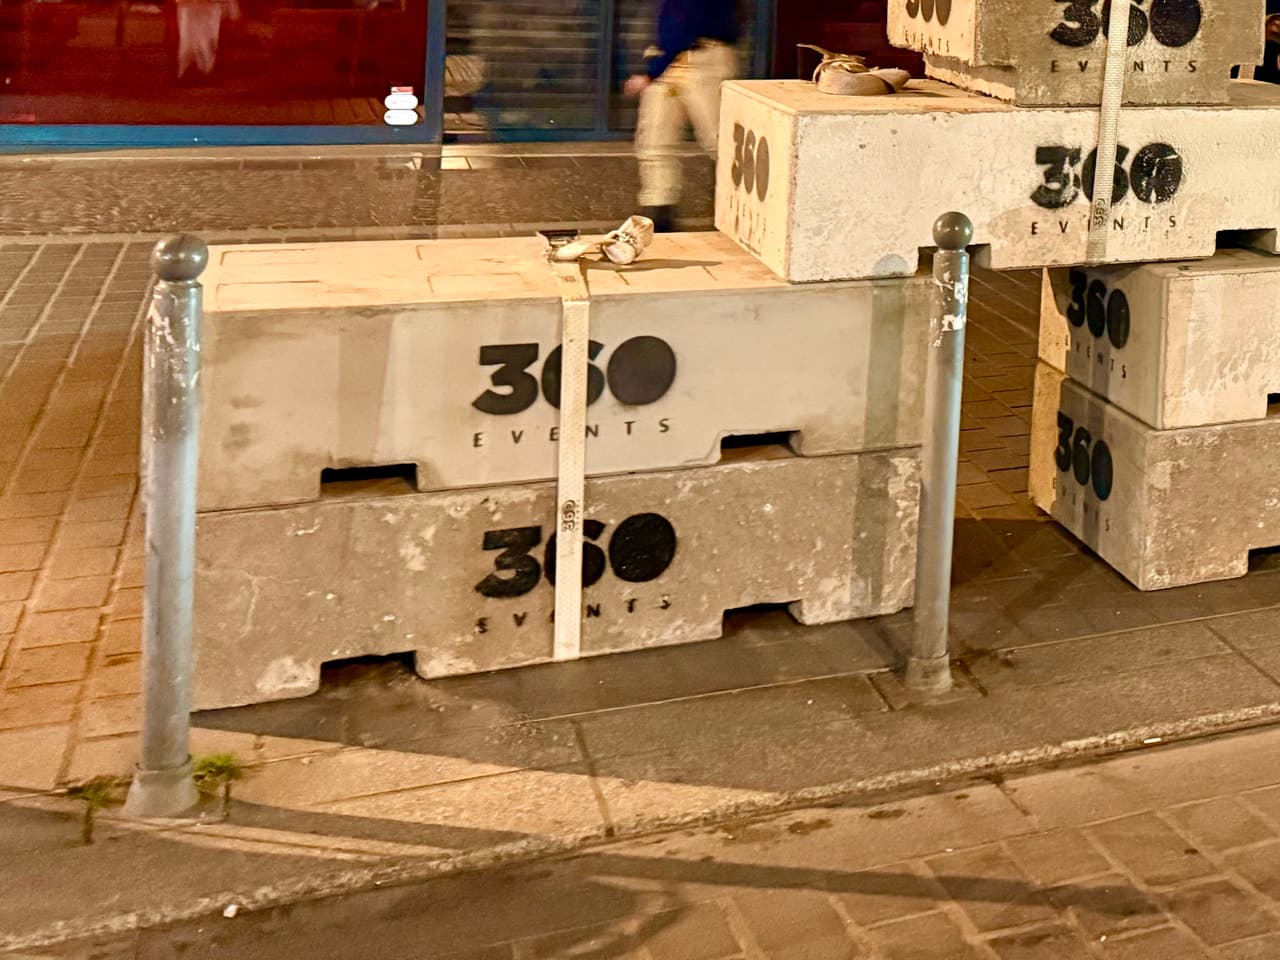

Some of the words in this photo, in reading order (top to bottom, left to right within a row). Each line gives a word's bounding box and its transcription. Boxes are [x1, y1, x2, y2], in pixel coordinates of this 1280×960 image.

[1050, 60, 1198, 74] EVNTS
[731, 122, 770, 203] 360
[1030, 142, 1184, 210] 360
[1031, 215, 1177, 236] EVNTS
[1066, 270, 1131, 350] 360
[472, 335, 677, 416] 360
[473, 418, 670, 447] EVENTS
[1055, 410, 1114, 502] 360
[474, 512, 677, 600] 360
[476, 595, 672, 635] EVNTS
